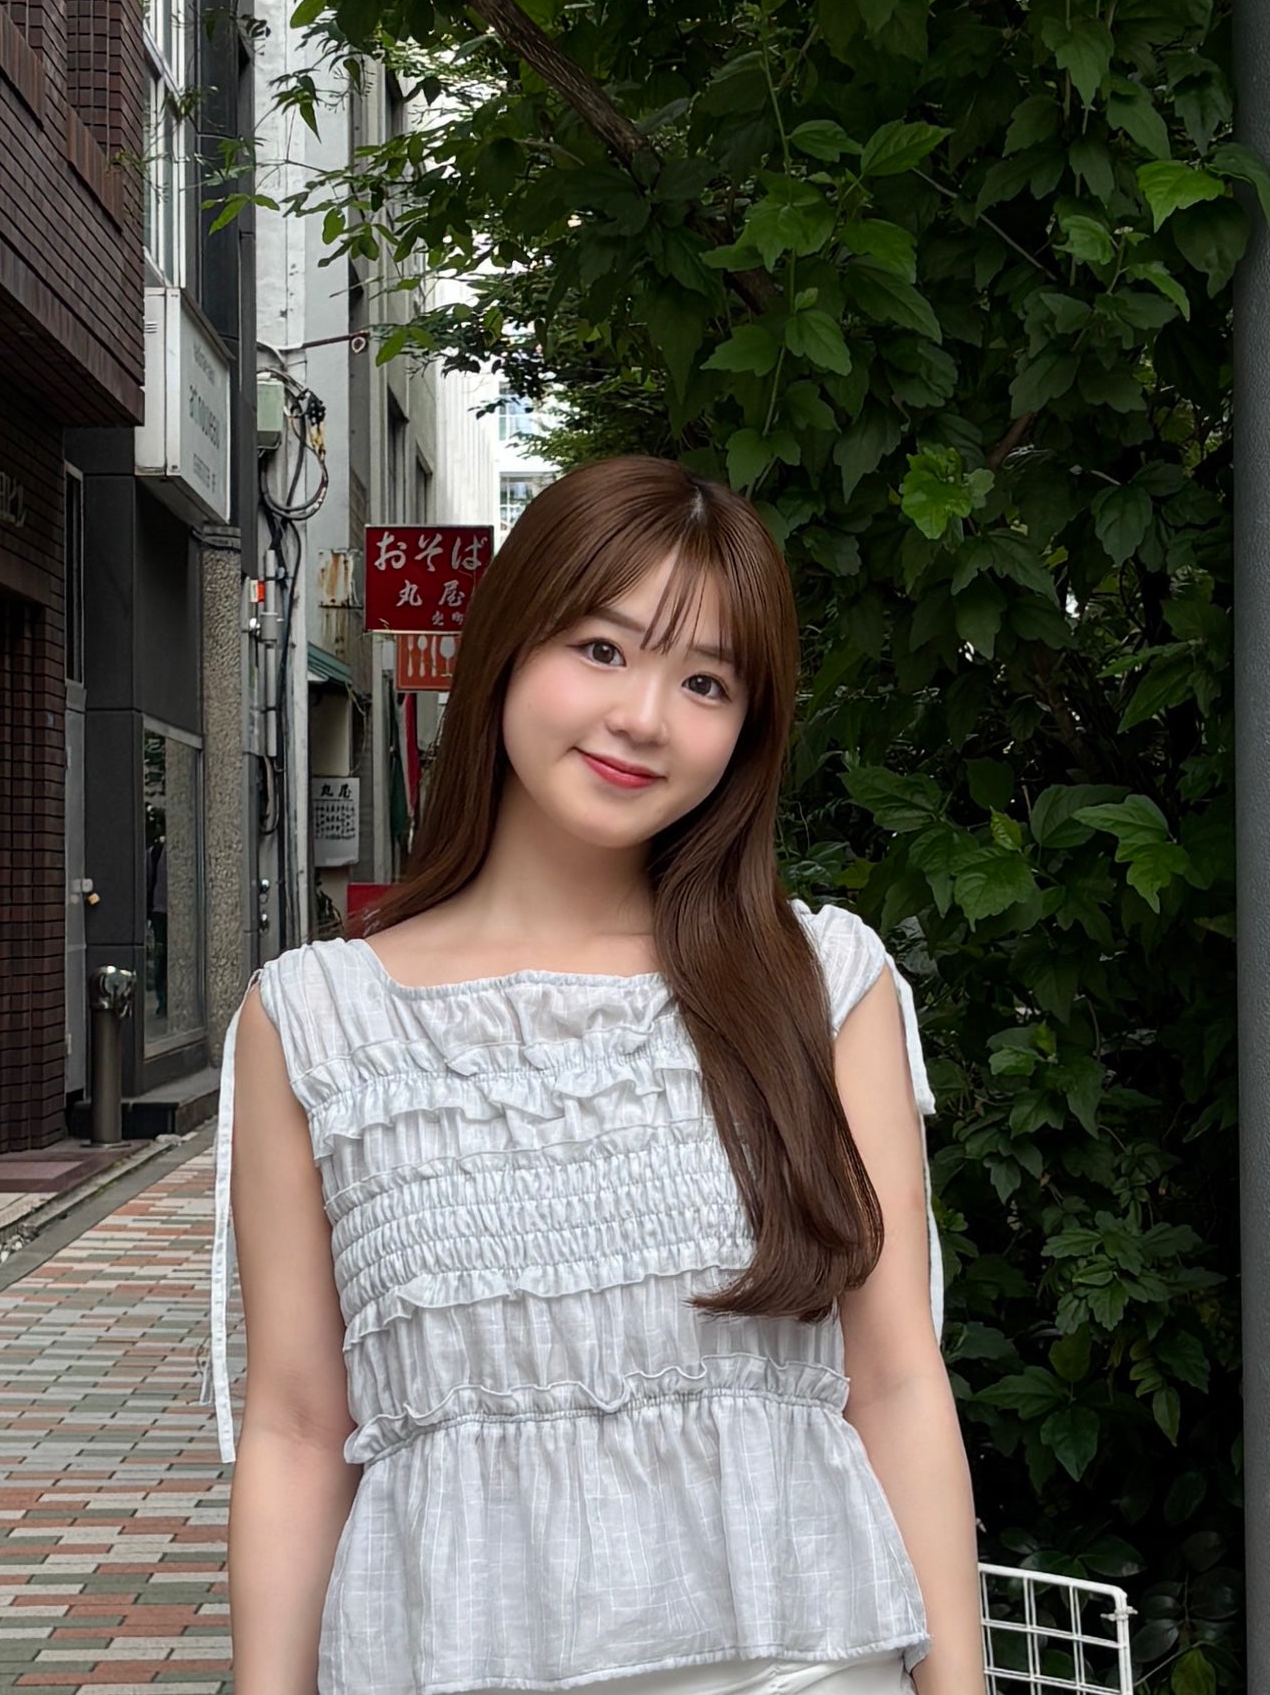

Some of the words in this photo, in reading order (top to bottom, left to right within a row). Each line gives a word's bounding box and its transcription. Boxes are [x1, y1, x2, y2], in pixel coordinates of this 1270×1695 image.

[374, 530, 488, 572] おそば
[396, 579, 466, 607] 丸屋
